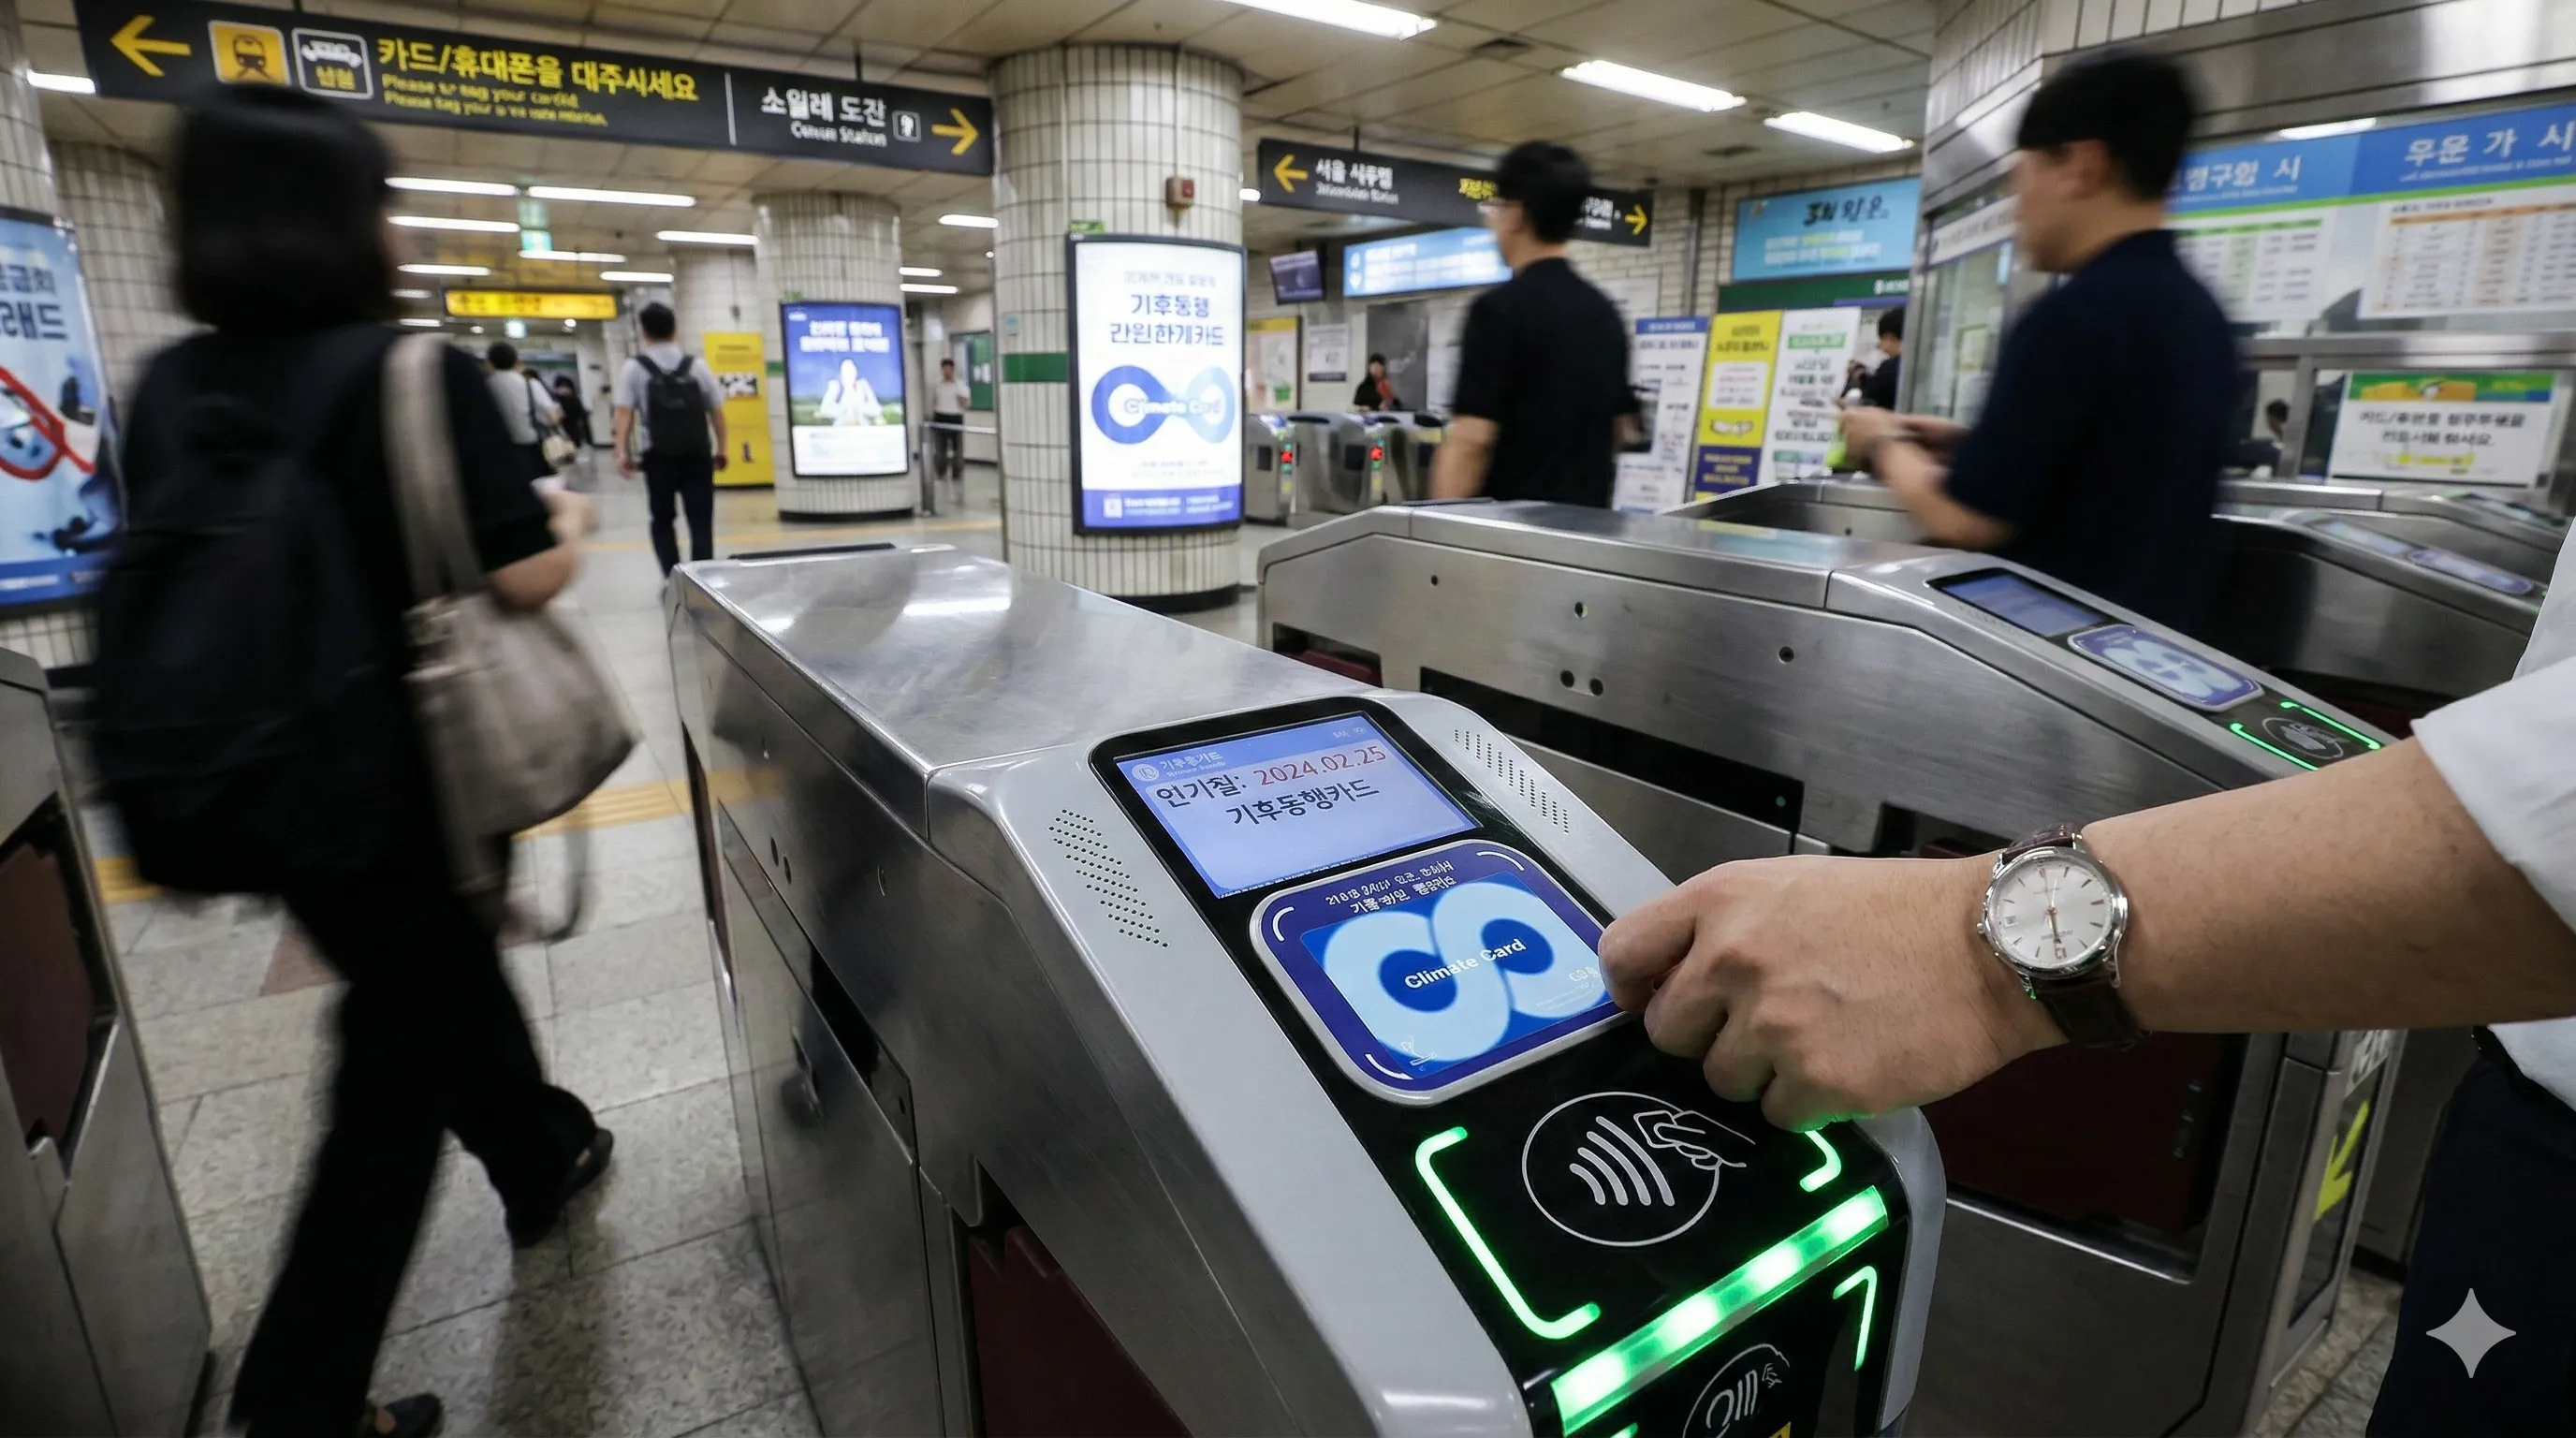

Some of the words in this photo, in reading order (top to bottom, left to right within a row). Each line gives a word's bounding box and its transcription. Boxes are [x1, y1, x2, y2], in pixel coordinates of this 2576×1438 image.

[1252, 745, 1387, 786] 2024.02.25
[1225, 779, 1381, 826] 기후동행카드
[1404, 958, 1479, 989] Climate
[1480, 938, 1527, 961] Card
